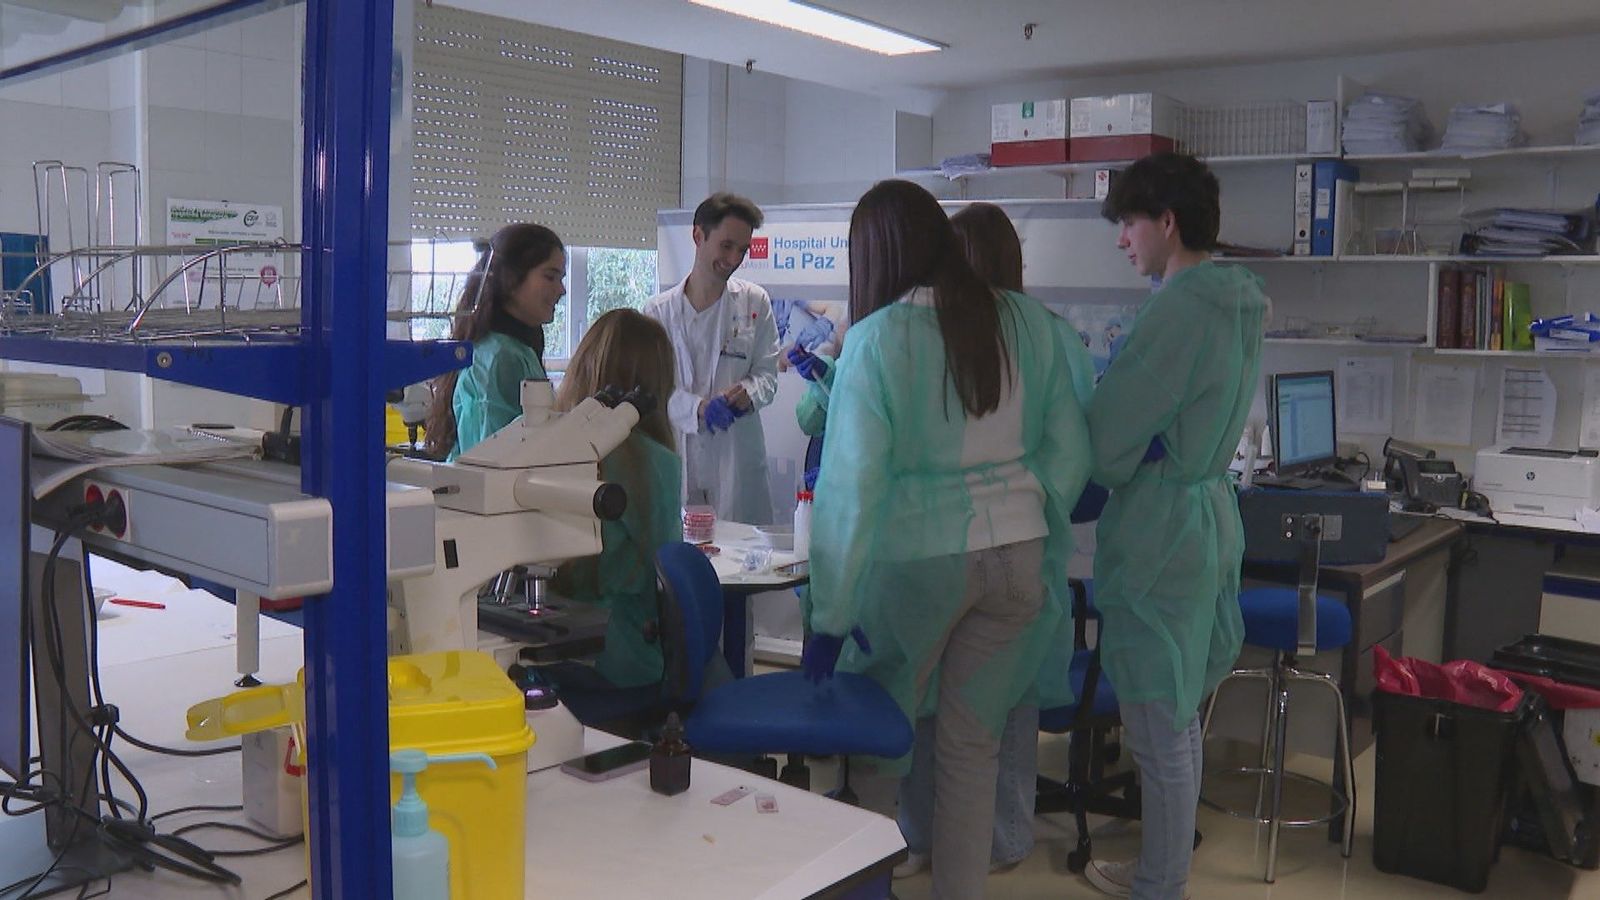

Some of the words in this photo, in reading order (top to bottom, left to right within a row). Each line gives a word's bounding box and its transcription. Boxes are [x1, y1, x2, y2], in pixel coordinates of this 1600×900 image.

[774, 237, 826, 251] Hospital
[830, 237, 848, 248] Un
[773, 253, 795, 269] La
[802, 253, 835, 269] Paz
